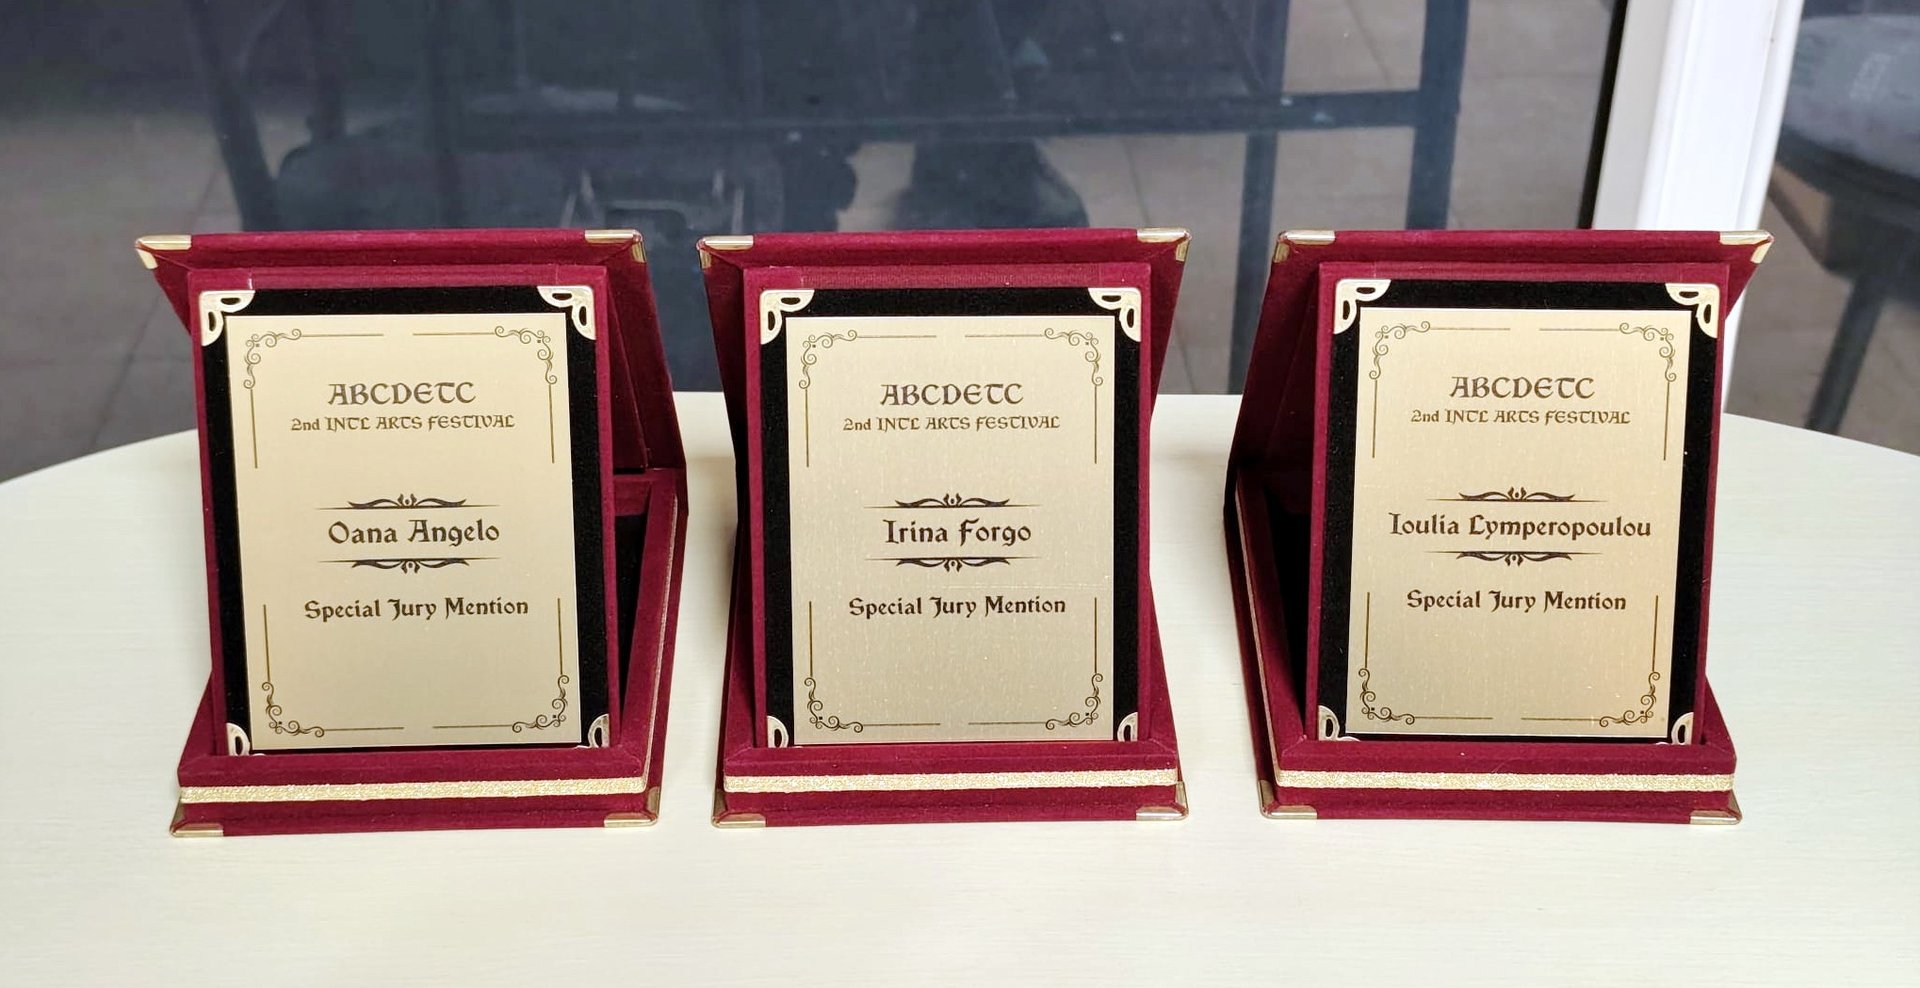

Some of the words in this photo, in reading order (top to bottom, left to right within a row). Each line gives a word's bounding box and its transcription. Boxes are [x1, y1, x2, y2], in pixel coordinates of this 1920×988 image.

[327, 381, 477, 406] ABCDETC
[879, 382, 1024, 407] ABCDETC
[1448, 376, 1596, 400] ABCDETC
[290, 417, 321, 432] 2nd
[323, 416, 371, 433] INTL
[375, 415, 423, 430] ARTS
[427, 414, 516, 432] FESTIVAL
[842, 417, 872, 431] 2nd
[875, 416, 921, 433] INTL
[924, 416, 971, 430] ARTS
[975, 415, 1061, 433] FESTIVAL
[1410, 409, 1440, 423] 2nd
[1444, 408, 1489, 425] INTL
[1492, 409, 1540, 424] ARTS
[1544, 409, 1631, 426] FESTIVAL
[327, 520, 399, 545] Oana
[407, 518, 500, 548] Angelo
[882, 518, 949, 545] Irina
[957, 517, 1032, 547] Forgo
[1387, 511, 1460, 536] Ioulia
[1468, 514, 1652, 542] Lymperopoulou
[304, 598, 382, 623] Special
[386, 598, 437, 622] Jury
[444, 596, 529, 620] Mention
[848, 596, 923, 620] Special
[928, 596, 977, 619] Jury
[984, 595, 1066, 618] Mention
[1406, 588, 1481, 613] Special
[1487, 589, 1537, 614] Jury
[1543, 590, 1627, 614] Mention
